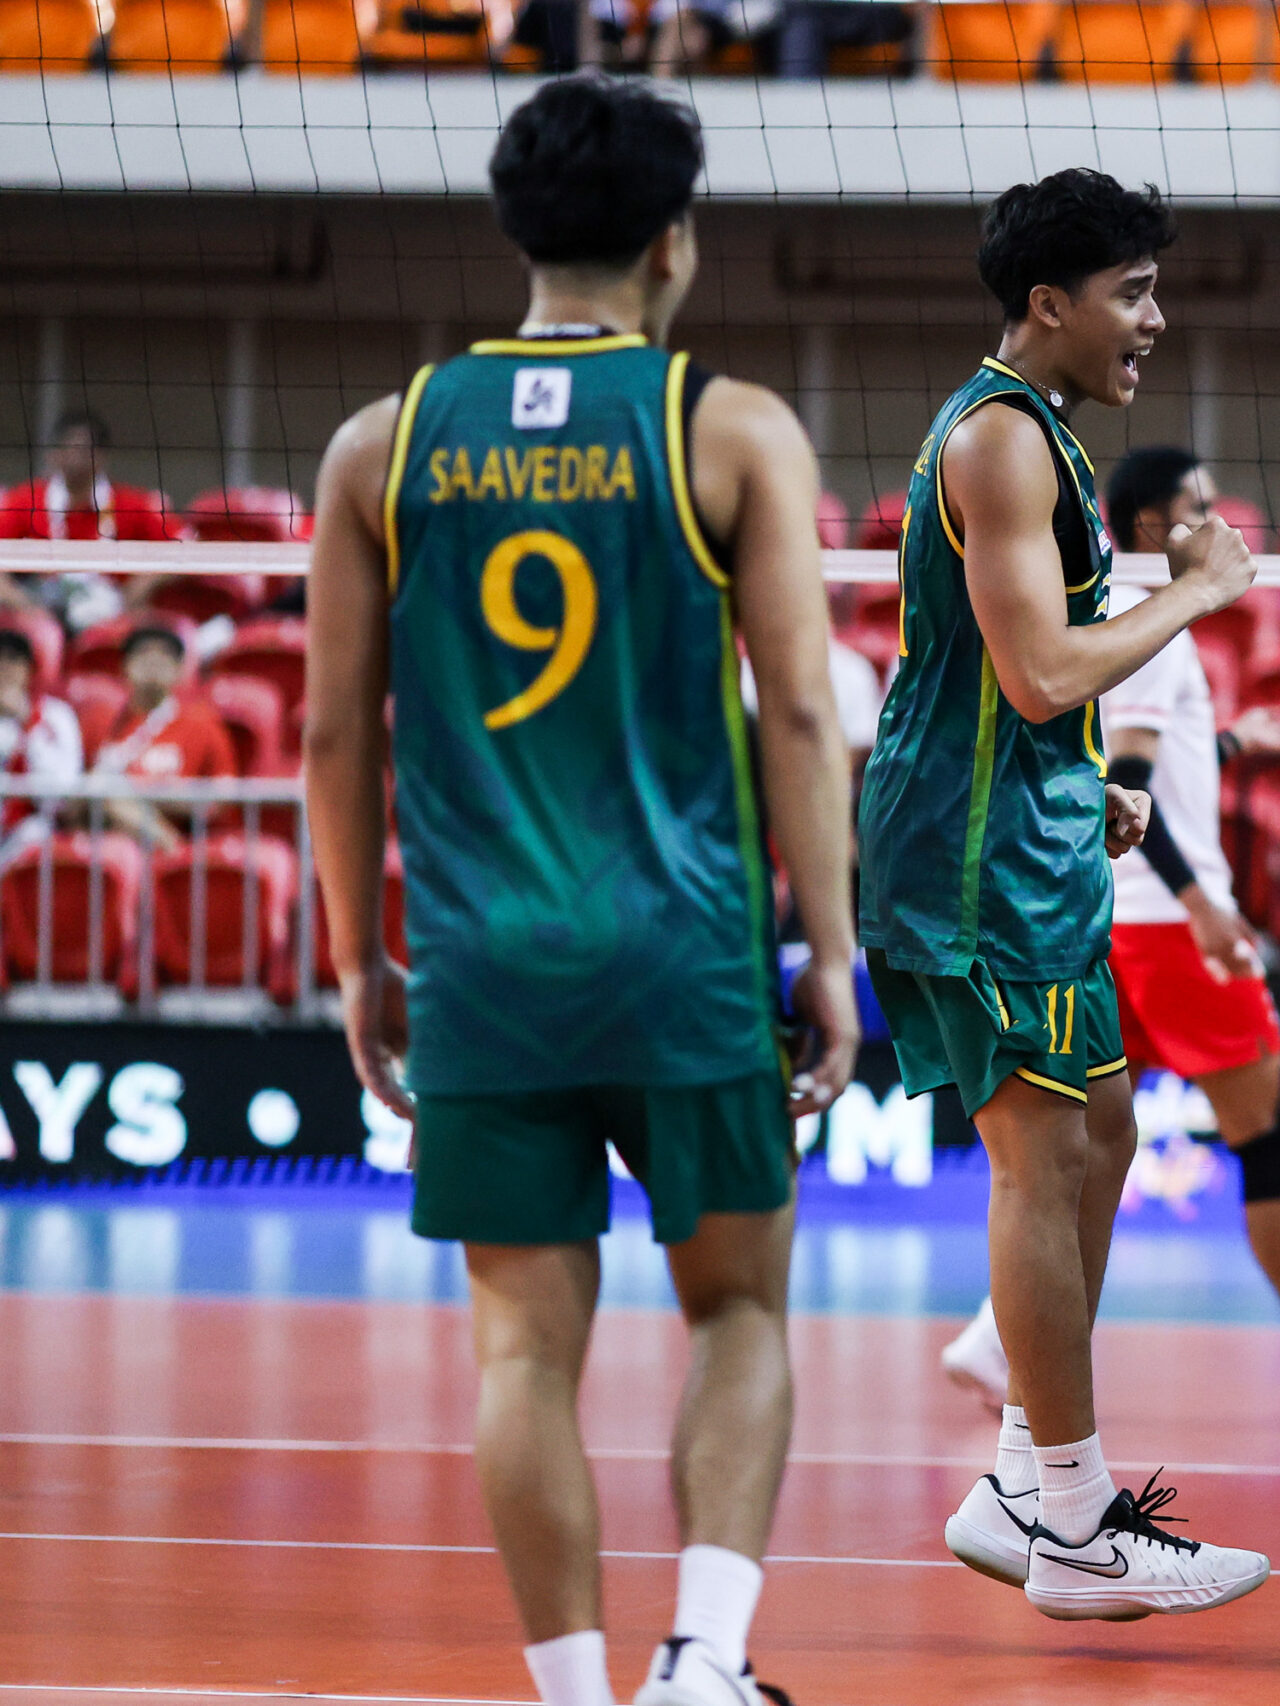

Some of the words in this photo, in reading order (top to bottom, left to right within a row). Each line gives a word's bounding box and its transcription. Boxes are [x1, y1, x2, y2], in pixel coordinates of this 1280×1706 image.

[429, 445, 637, 503] SAAVEDRA
[481, 529, 597, 732] 9
[1046, 984, 1075, 1054] 11
[0, 1060, 189, 1167] YS
